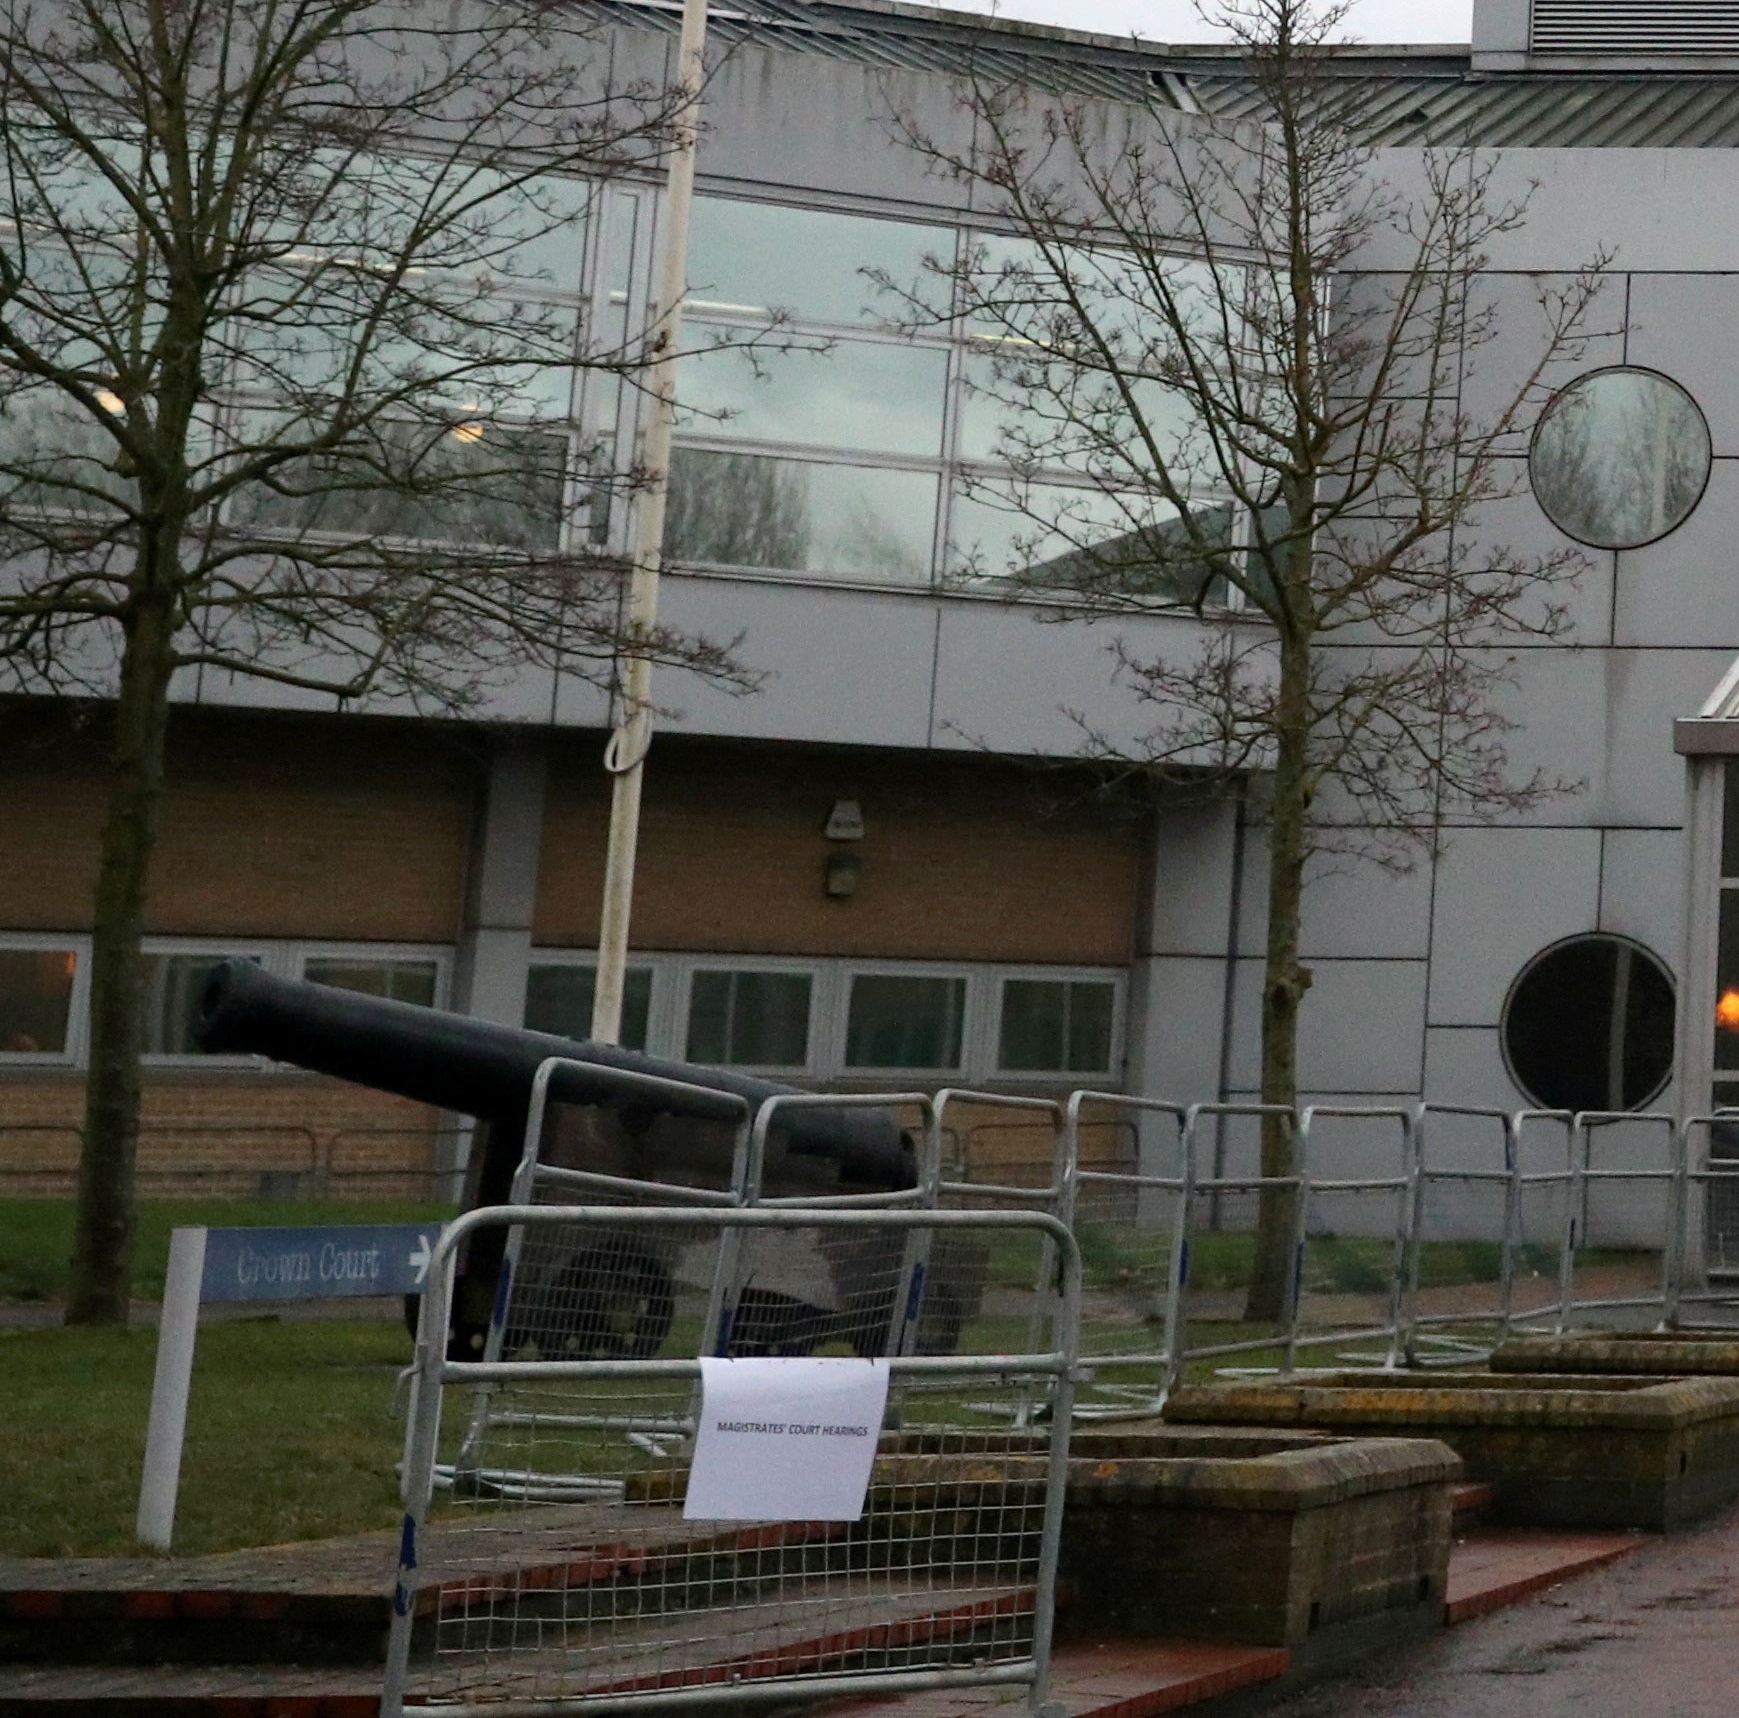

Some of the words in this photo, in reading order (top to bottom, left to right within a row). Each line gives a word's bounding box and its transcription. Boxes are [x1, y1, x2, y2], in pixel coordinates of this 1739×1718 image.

[237, 1247, 311, 1283] Crown
[319, 1242, 380, 1280] Court
[716, 1422, 787, 1433] MAGISTRATES'
[788, 1424, 820, 1435] COURT
[822, 1425, 869, 1437] HEARINGS
